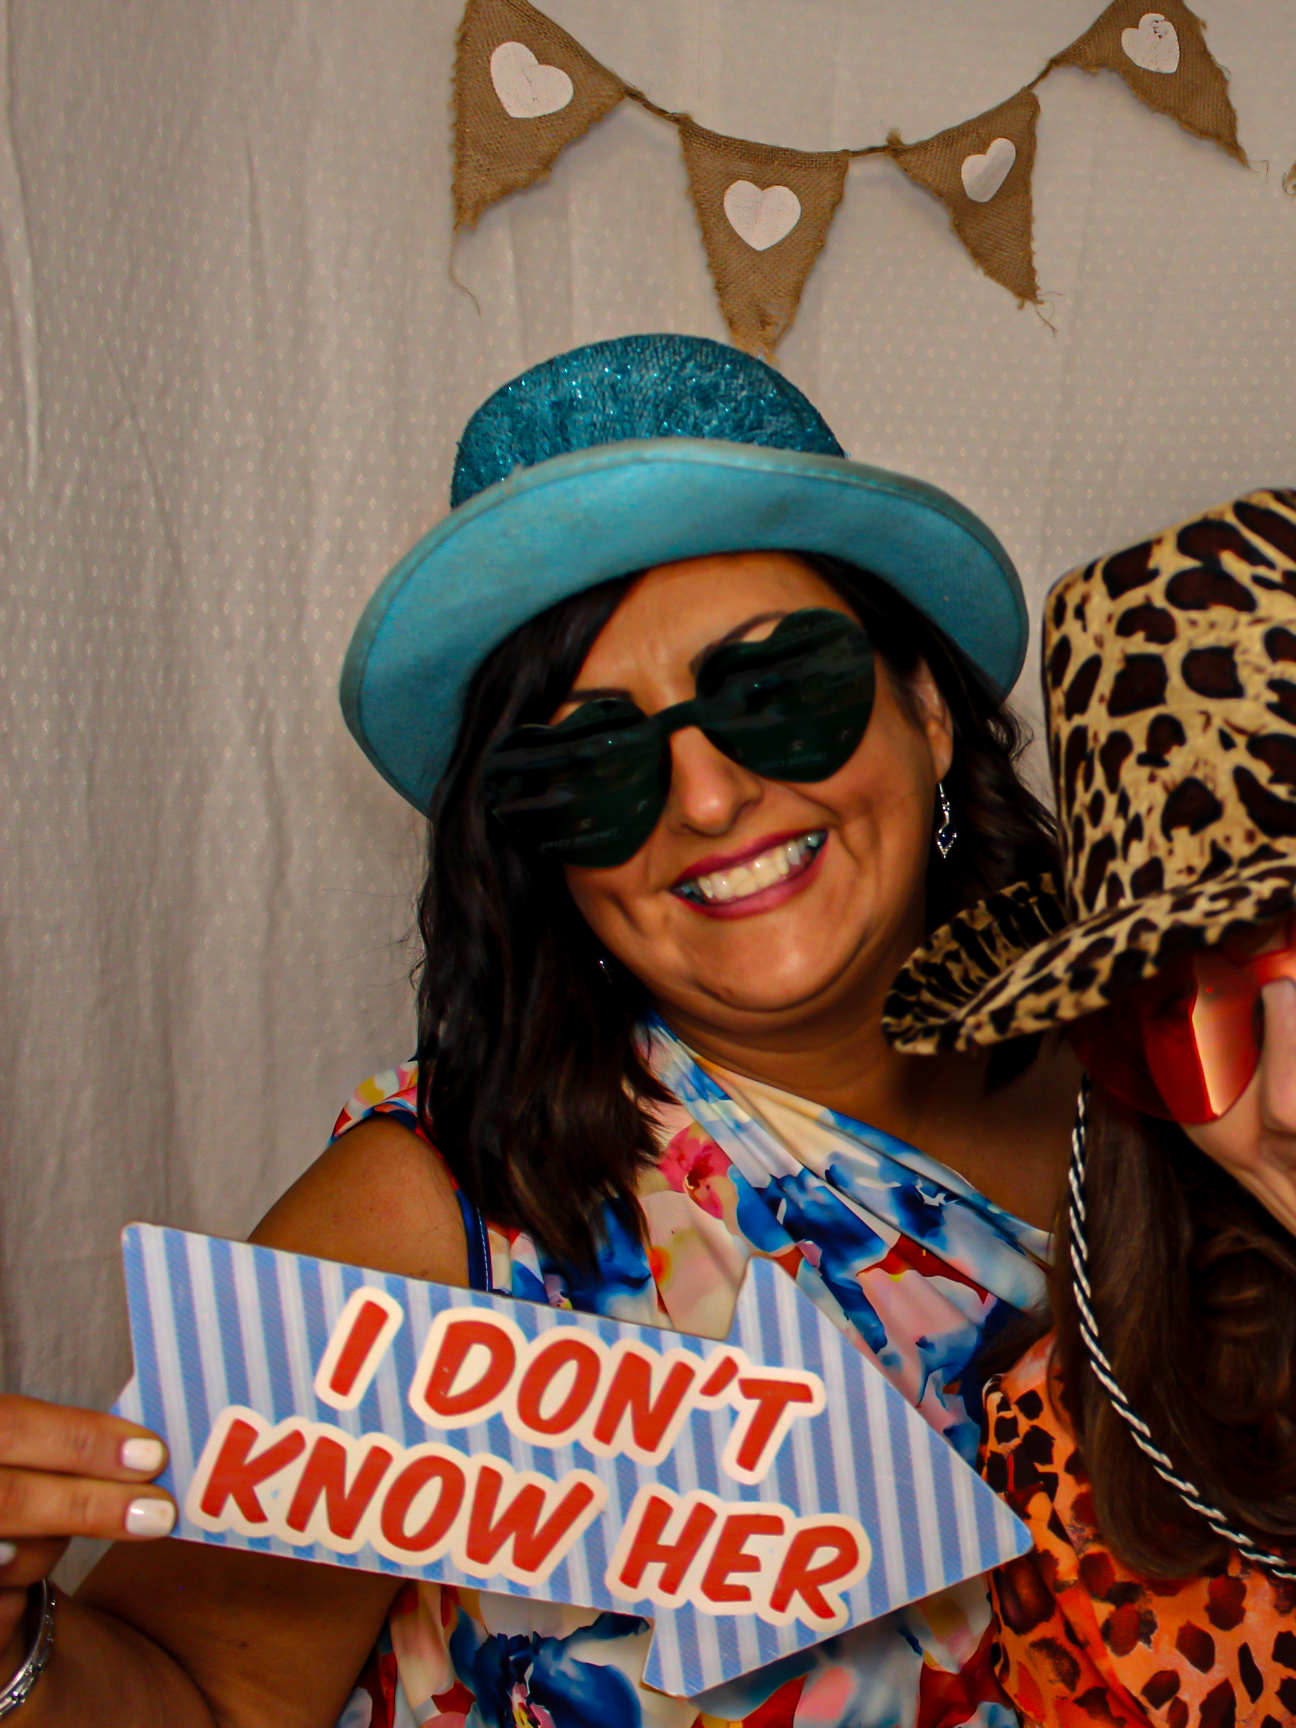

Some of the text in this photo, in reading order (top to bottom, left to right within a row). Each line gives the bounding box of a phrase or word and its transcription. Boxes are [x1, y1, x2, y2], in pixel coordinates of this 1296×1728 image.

[328, 1299, 813, 1473] I DON'T
[199, 1418, 860, 1621] KNOW HER
